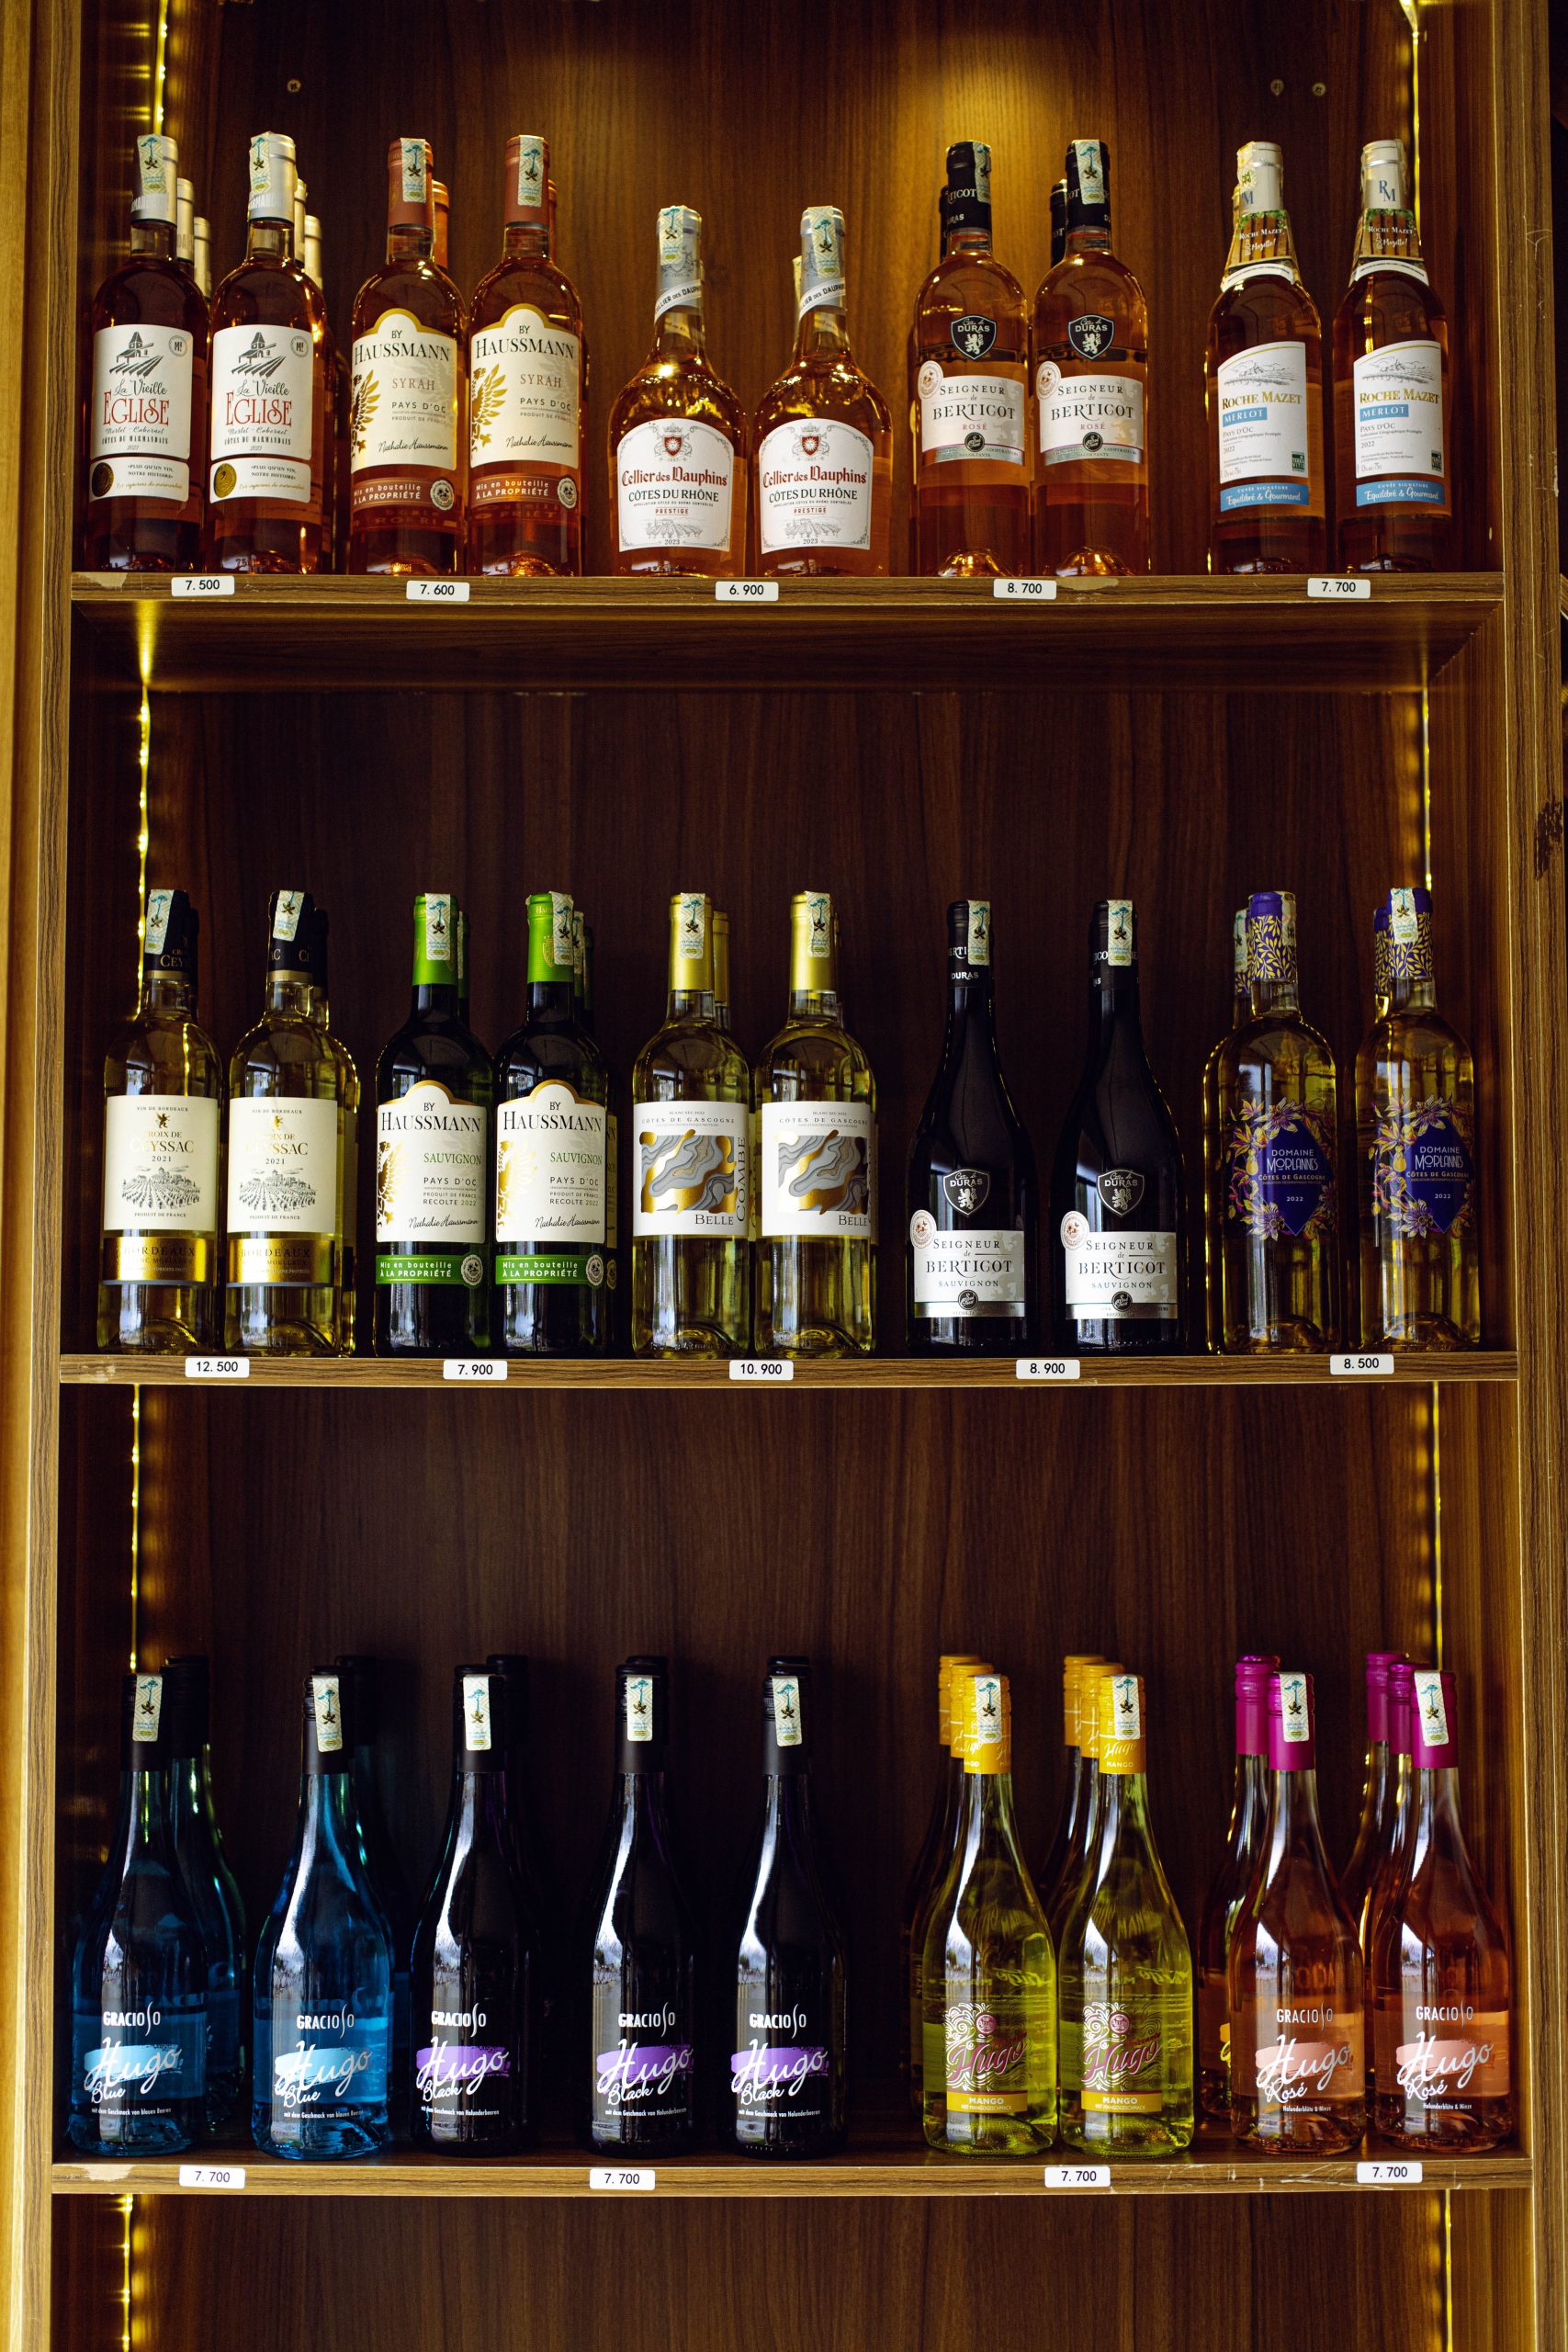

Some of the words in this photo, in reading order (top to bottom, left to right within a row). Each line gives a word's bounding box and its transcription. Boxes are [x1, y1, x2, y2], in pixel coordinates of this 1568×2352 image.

[391, 330, 403, 339] BY
[518, 325, 530, 334] BY
[355, 343, 450, 366] HAUSSMANN
[476, 338, 574, 360] HAUSSMANN
[114, 379, 131, 396] La
[130, 379, 168, 395] Vieille
[236, 379, 255, 397] La
[253, 379, 290, 396] Vieille
[392, 378, 435, 390] SYRAH
[520, 374, 561, 388] SYRAH
[940, 384, 1005, 396] SEIGNEUR
[1058, 385, 1122, 395] SEIGNEUR
[1359, 390, 1400, 404] ROCHE
[1403, 388, 1440, 404] MAZET
[520, 398, 546, 406] PAYS
[550, 399, 571, 411] D'OC
[1222, 393, 1258, 410] ROCHE
[1261, 391, 1303, 404] MAZET
[933, 404, 1015, 421] BERTICOT
[1051, 404, 1134, 421] BERTICOT
[1225, 410, 1263, 423] MERLOT
[1362, 408, 1404, 418] MERLOT
[1080, 422, 1106, 430] ROSÉ
[378, 441, 409, 452] Nathalie
[409, 437, 448, 450] Haussmann
[505, 435, 536, 448] Nathalie
[536, 434, 573, 447] Haussmann
[622, 469, 656, 487] Cellier
[656, 472, 671, 482] des
[672, 467, 727, 487] Dauphins
[763, 470, 794, 488] Cellier
[794, 472, 808, 481] des
[810, 466, 867, 484] Dauphins
[505, 480, 549, 489] bouteille
[482, 491, 492, 499] LA
[495, 487, 549, 496] PROPRIÉTÉ
[628, 489, 660, 502] CÔTES
[663, 490, 679, 499] DU
[682, 489, 719, 502] RHÔNE
[770, 490, 798, 503] CÔTES
[801, 489, 817, 499] DU
[819, 488, 858, 500] RHÔNE
[1407, 486, 1439, 500] Gourmand
[185, 579, 220, 591] 7.500
[420, 583, 455, 596] 7.600
[728, 584, 764, 595] 6.900
[1007, 582, 1043, 594] 8.700
[1321, 581, 1357, 593] 7.700
[423, 1102, 434, 1112] BY
[549, 1102, 560, 1111] BY
[382, 1112, 480, 1132] HAUSSMANN
[503, 1112, 602, 1132] HAUSSMANN
[423, 1152, 481, 1165] SAUVIGNON
[550, 1152, 603, 1165] SAUVIGNON
[550, 1177, 575, 1185] PAYS
[580, 1178, 599, 1186] D'OC
[737, 1137, 746, 1222] COMBE
[1104, 1180, 1138, 1188] DURAS
[408, 1216, 439, 1227] Nathalie
[439, 1214, 478, 1227] Haussmann
[535, 1216, 567, 1227] Nathalie
[567, 1214, 600, 1227] Haussmann
[695, 1215, 734, 1226] BELLE
[838, 1215, 867, 1227] BELLE
[933, 1239, 999, 1250] SEIGNEUR
[1086, 1240, 1154, 1250] SEIGNEUR
[502, 1268, 507, 1277] À
[524, 1268, 577, 1277] PROPRIÉTÉ
[926, 1261, 1012, 1278] BERTICOT
[1078, 1262, 1165, 1280] BERTICOT
[197, 1361, 239, 1373] 12.500
[457, 1363, 493, 1375] 7.900
[740, 1363, 783, 1375] 10.900
[1030, 1363, 1066, 1374] 8.900
[1343, 1357, 1380, 1370] 8.500
[1104, 1742, 1137, 1760] Hugo
[103, 2001, 161, 2036] GRACIOSO
[432, 2003, 487, 2038] GRACIOSO
[618, 2002, 675, 2038] GRACIOSO
[1277, 2000, 1334, 2030] GRACIOSO
[1416, 1999, 1473, 2029] GRACIOSO
[297, 2005, 355, 2039] GRACIOSO
[750, 2004, 807, 2039] GRACIOSO
[85, 2037, 182, 2095] Hugo
[415, 2036, 509, 2095] Hugo
[597, 2038, 694, 2095] Hugo
[947, 2040, 1027, 2081] Hugo
[1082, 2041, 1161, 2081] Hugo
[1256, 2034, 1351, 2091] Hugo
[1396, 2031, 1494, 2089] Hugo
[275, 2041, 373, 2097] Hugo
[731, 2038, 829, 2097] Hugo
[92, 2082, 126, 2104] Blue
[423, 2078, 463, 2102] Black
[608, 2080, 654, 2106] Black
[740, 2082, 784, 2106] Black
[1265, 2078, 1308, 2104] Rosé
[1405, 2075, 1448, 2100] Rosé
[284, 2085, 321, 2108] Blue
[196, 2170, 231, 2183] 7.700
[1061, 2170, 1097, 2182] 7.700
[1372, 2166, 1408, 2177] 7.700
[604, 2173, 640, 2185] 7.700
